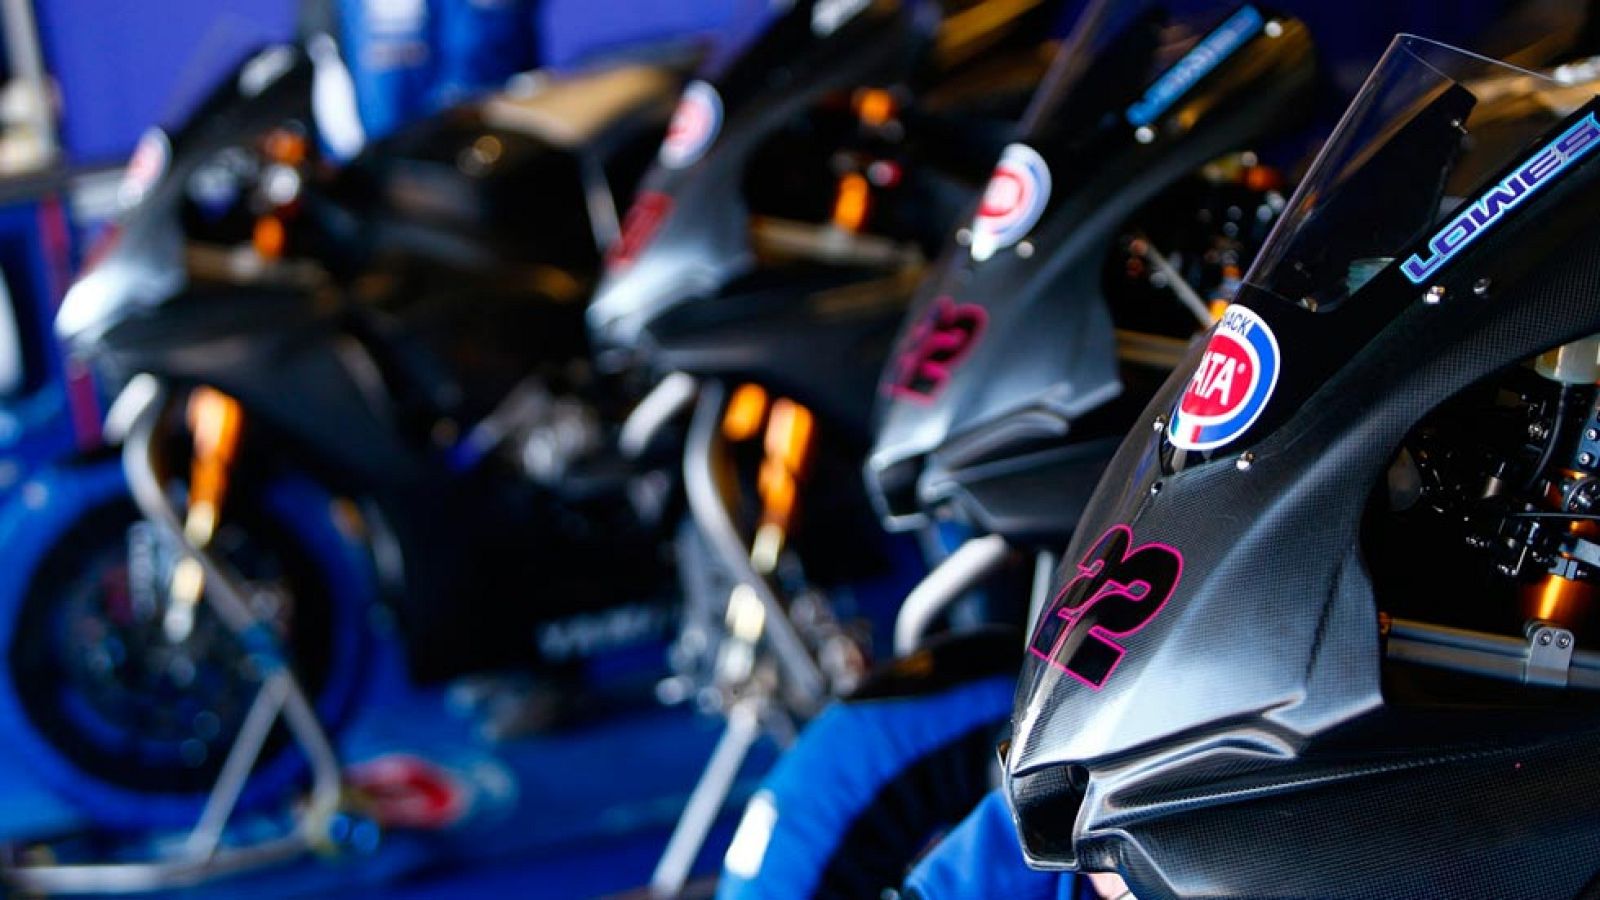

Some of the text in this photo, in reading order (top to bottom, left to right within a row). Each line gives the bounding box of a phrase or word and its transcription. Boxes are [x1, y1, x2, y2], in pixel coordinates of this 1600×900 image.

[1401, 112, 1600, 283] LOWES
[1187, 350, 1237, 406] ATA
[1029, 523, 1184, 691] 22
